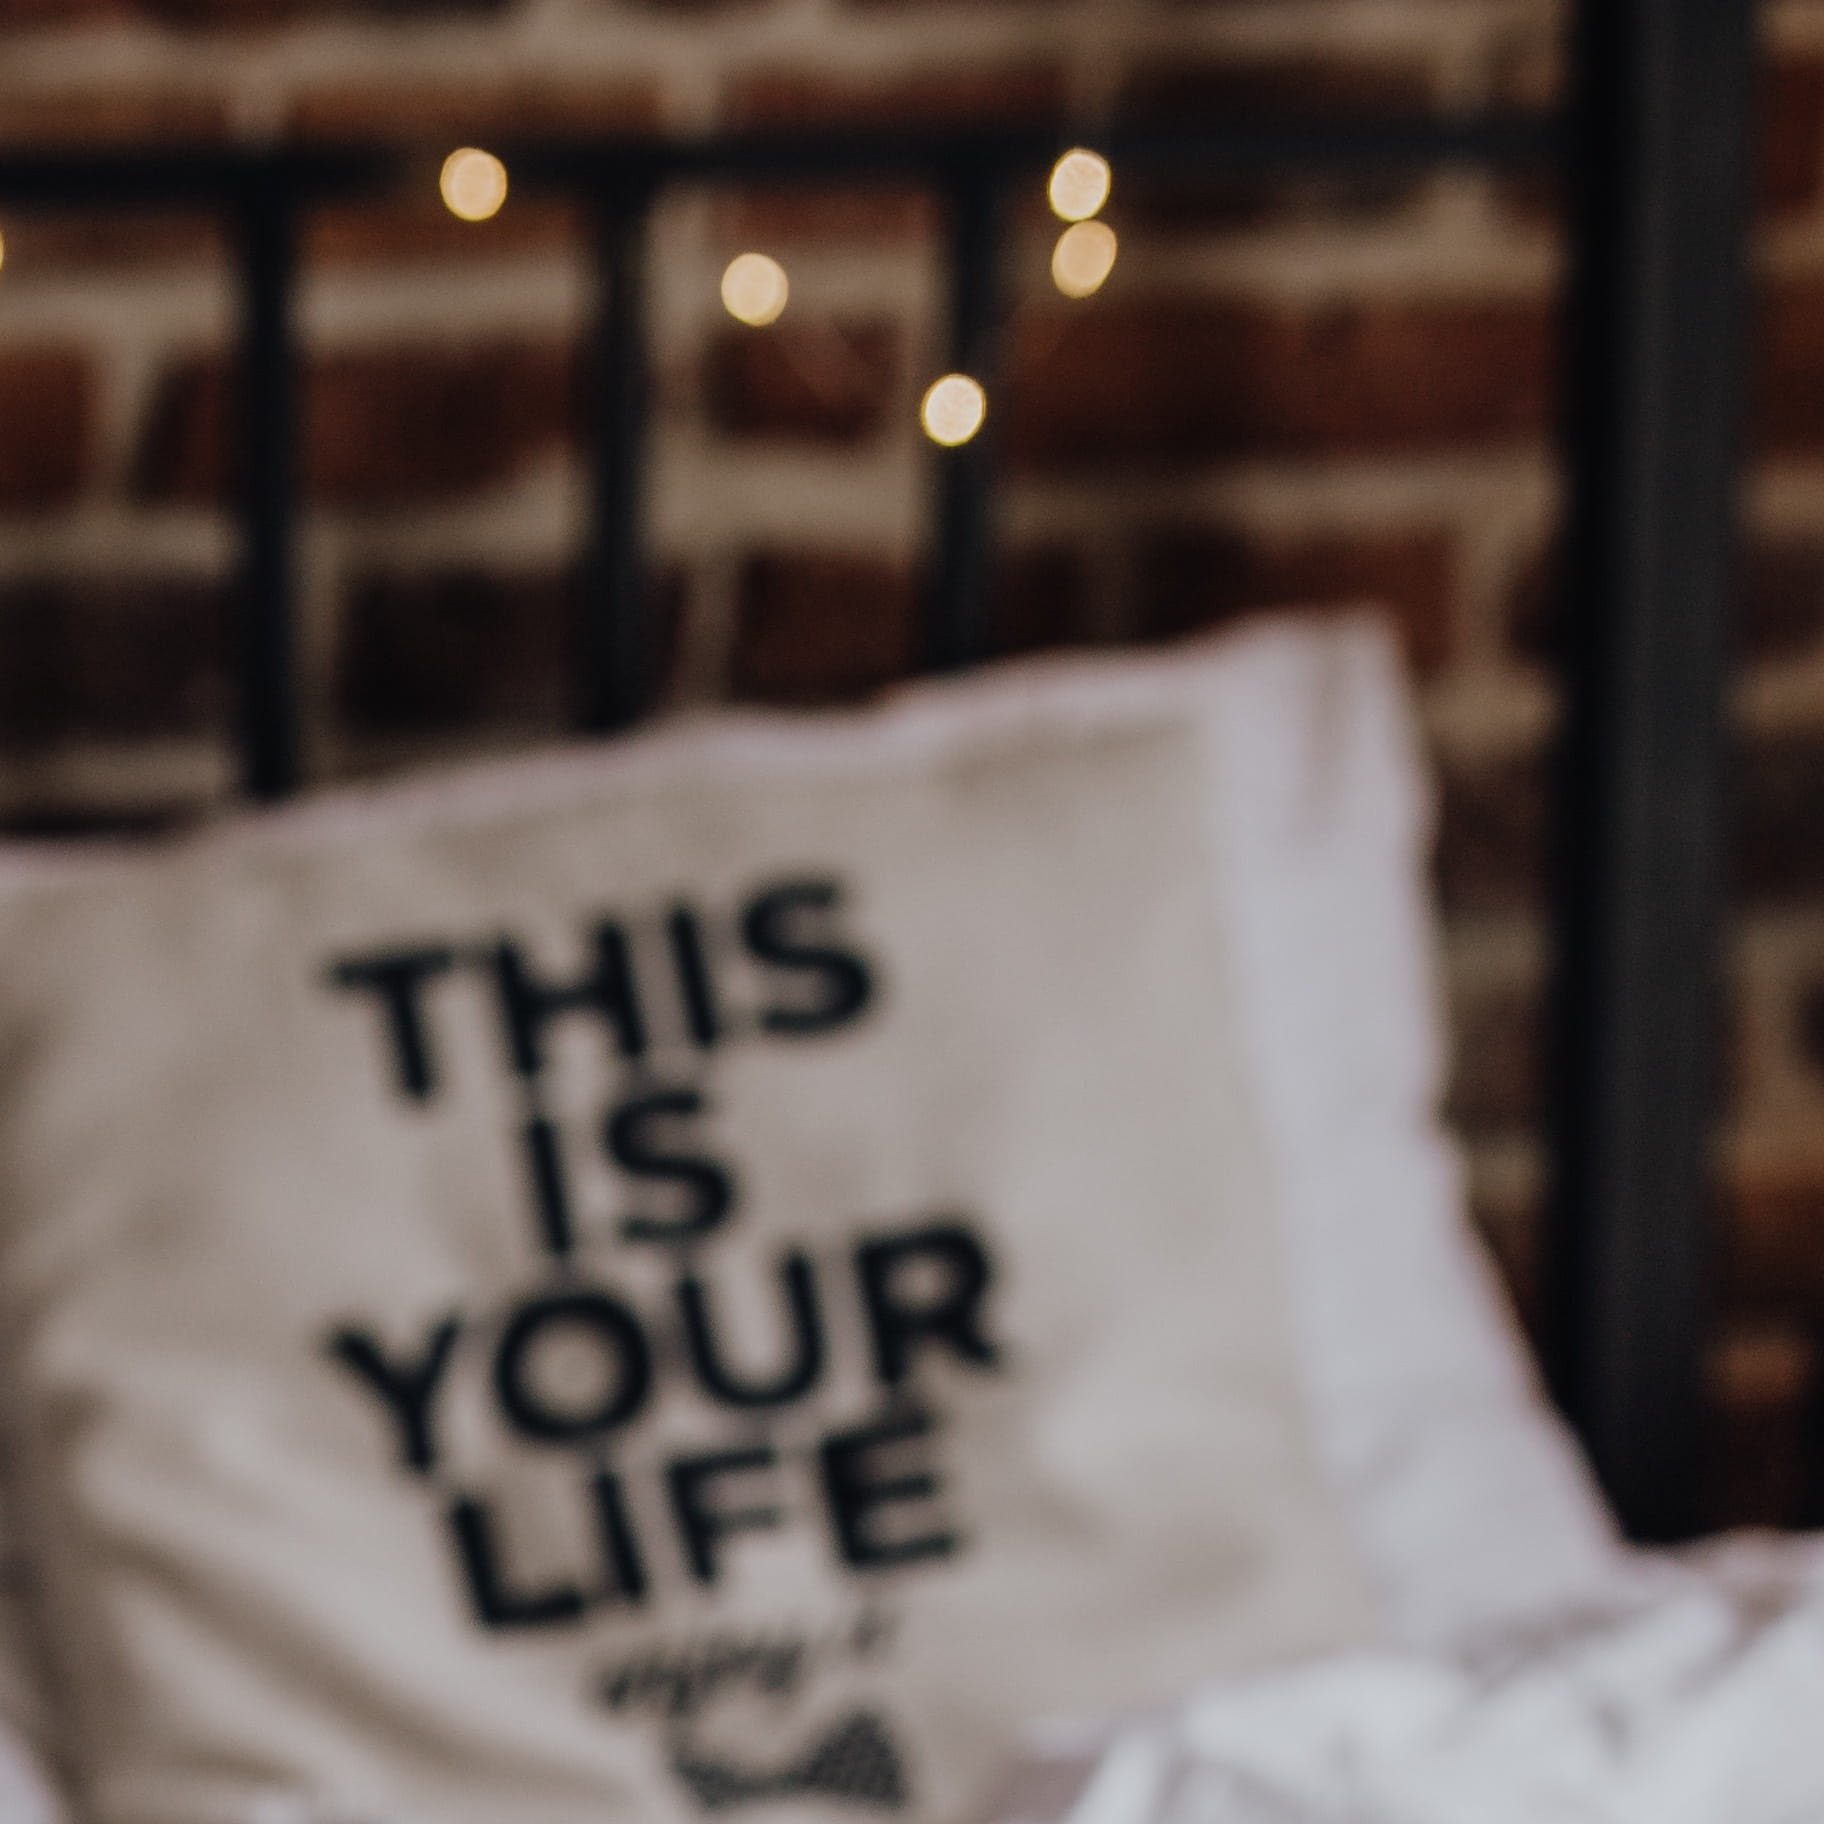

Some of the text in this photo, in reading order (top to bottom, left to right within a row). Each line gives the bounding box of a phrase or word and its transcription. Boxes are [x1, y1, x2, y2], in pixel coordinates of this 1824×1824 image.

[326, 876, 874, 1102] THIS
[526, 1088, 737, 1260] IS
[326, 1217, 999, 1473] YOUR
[449, 1404, 963, 1630] LIFE
